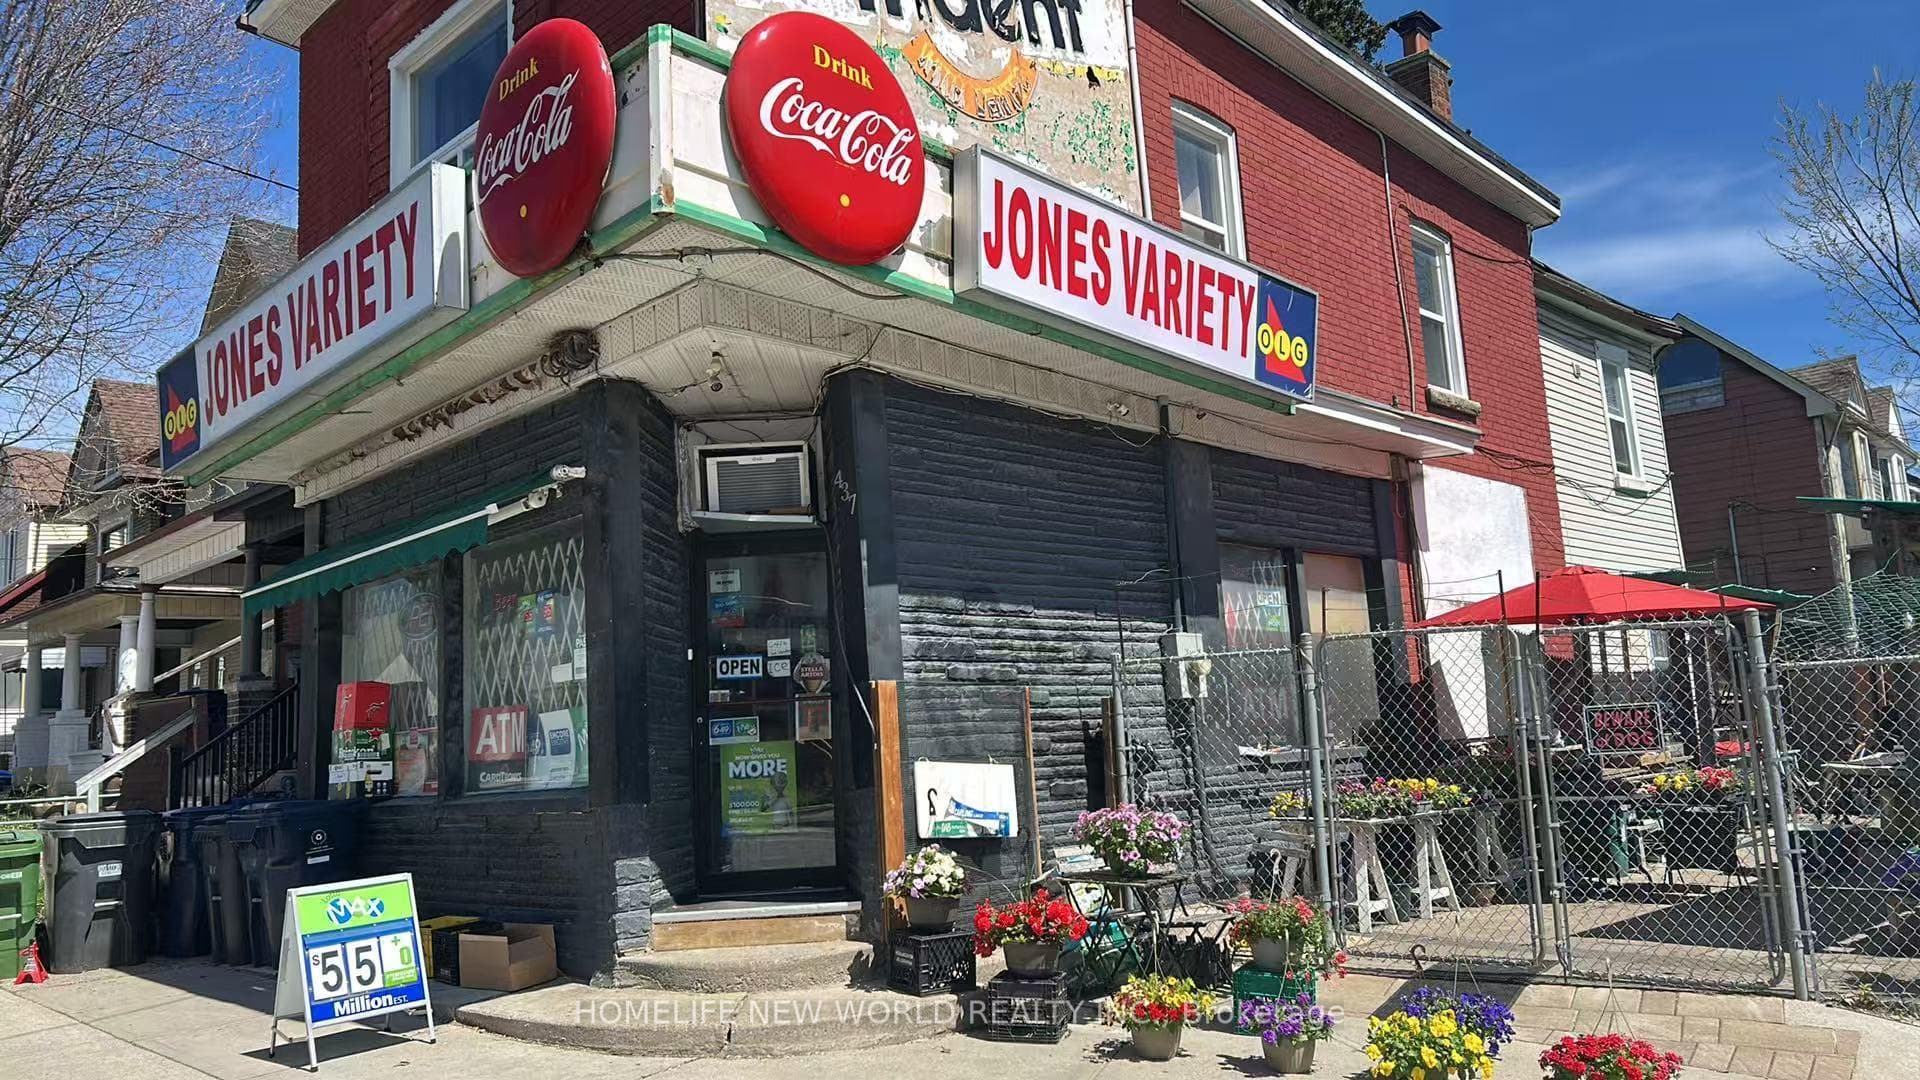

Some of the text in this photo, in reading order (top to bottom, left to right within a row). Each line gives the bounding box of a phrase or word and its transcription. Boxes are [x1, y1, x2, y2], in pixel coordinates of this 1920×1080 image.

[498, 57, 540, 102] Drink
[812, 44, 875, 90] Drink
[478, 69, 580, 201] Coca-Cola
[759, 77, 915, 186] Coca-Cola
[983, 178, 1256, 358] JONES VARIETY
[205, 202, 419, 427] JONES VARIETY
[1259, 325, 1306, 366] OLG
[164, 399, 196, 440] OLG
[834, 469, 857, 515] 437
[1257, 591, 1279, 606] OPEN
[719, 659, 760, 675] OPEN
[475, 710, 525, 755] ATM
[1594, 709, 1651, 729] BEWARE
[1614, 731, 1655, 747] DOG
[728, 759, 788, 778] MORE
[327, 896, 385, 925] MAX
[334, 993, 394, 1017] Million
